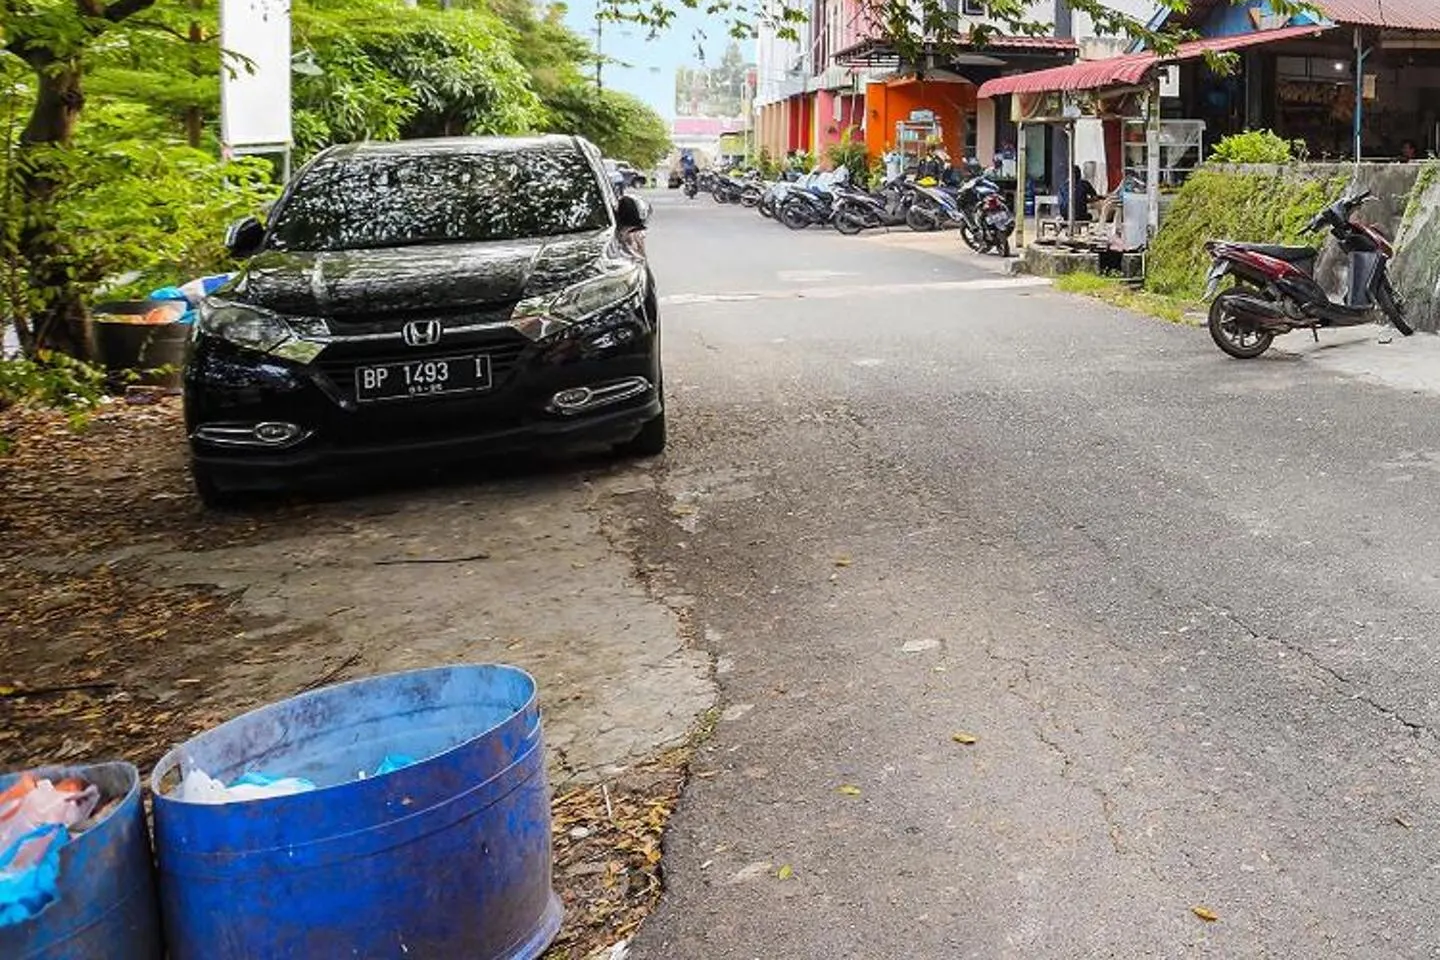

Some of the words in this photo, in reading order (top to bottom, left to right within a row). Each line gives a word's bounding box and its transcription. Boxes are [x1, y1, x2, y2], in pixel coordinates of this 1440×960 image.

[363, 367, 388, 389] BP
[403, 361, 449, 385] 1493
[475, 357, 483, 378] I
